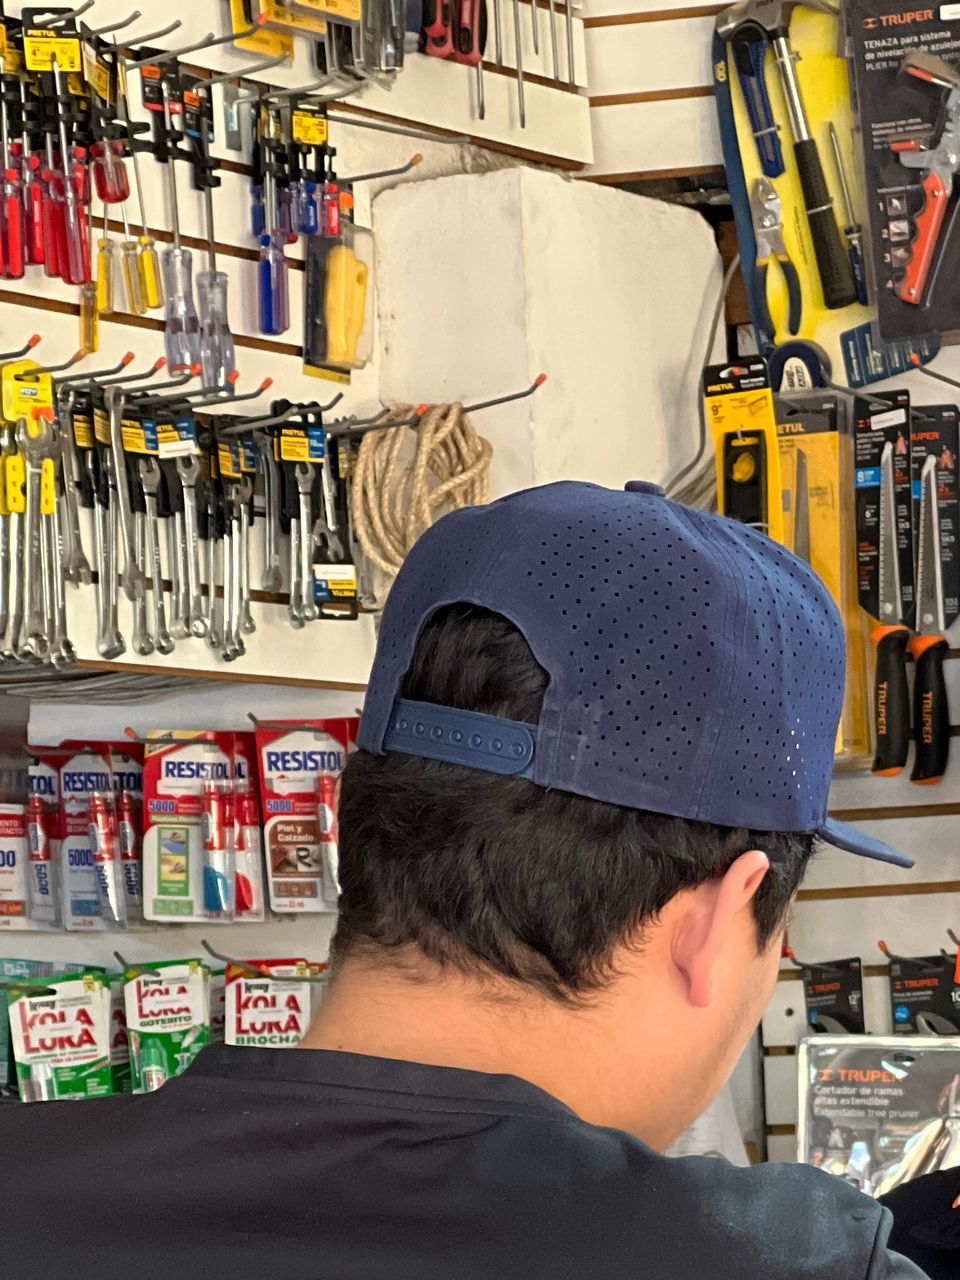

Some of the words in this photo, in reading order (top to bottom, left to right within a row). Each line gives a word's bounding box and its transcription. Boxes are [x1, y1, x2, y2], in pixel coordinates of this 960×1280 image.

[880, 10, 933, 26] TRUPER
[864, 37, 898, 49] TENAZA
[900, 35, 918, 45] para
[920, 31, 951, 42] sistema
[864, 51, 875, 60] de
[707, 383, 734, 393] PRETUL
[778, 423, 804, 434] ETUL
[878, 681, 888, 735] TRUPER
[922, 691, 933, 744] TRUPER
[165, 761, 229, 779] RESISTOL
[150, 800, 175, 812] 5000
[266, 800, 292, 812] 5000
[277, 824, 294, 833] Piel
[296, 826, 303, 834] y
[277, 834, 313, 842] Calzado
[905, 979, 940, 989] TRUPER
[140, 1016, 192, 1027] GOTERITO
[236, 1035, 300, 1045] BROCHA
[814, 1085, 856, 1095] Cortador
[860, 1087, 871, 1095] de
[814, 1096, 837, 1105] altas
[840, 1096, 889, 1106] extendible
[868, 1109, 886, 1117] tree
[889, 1110, 919, 1119] pruner
